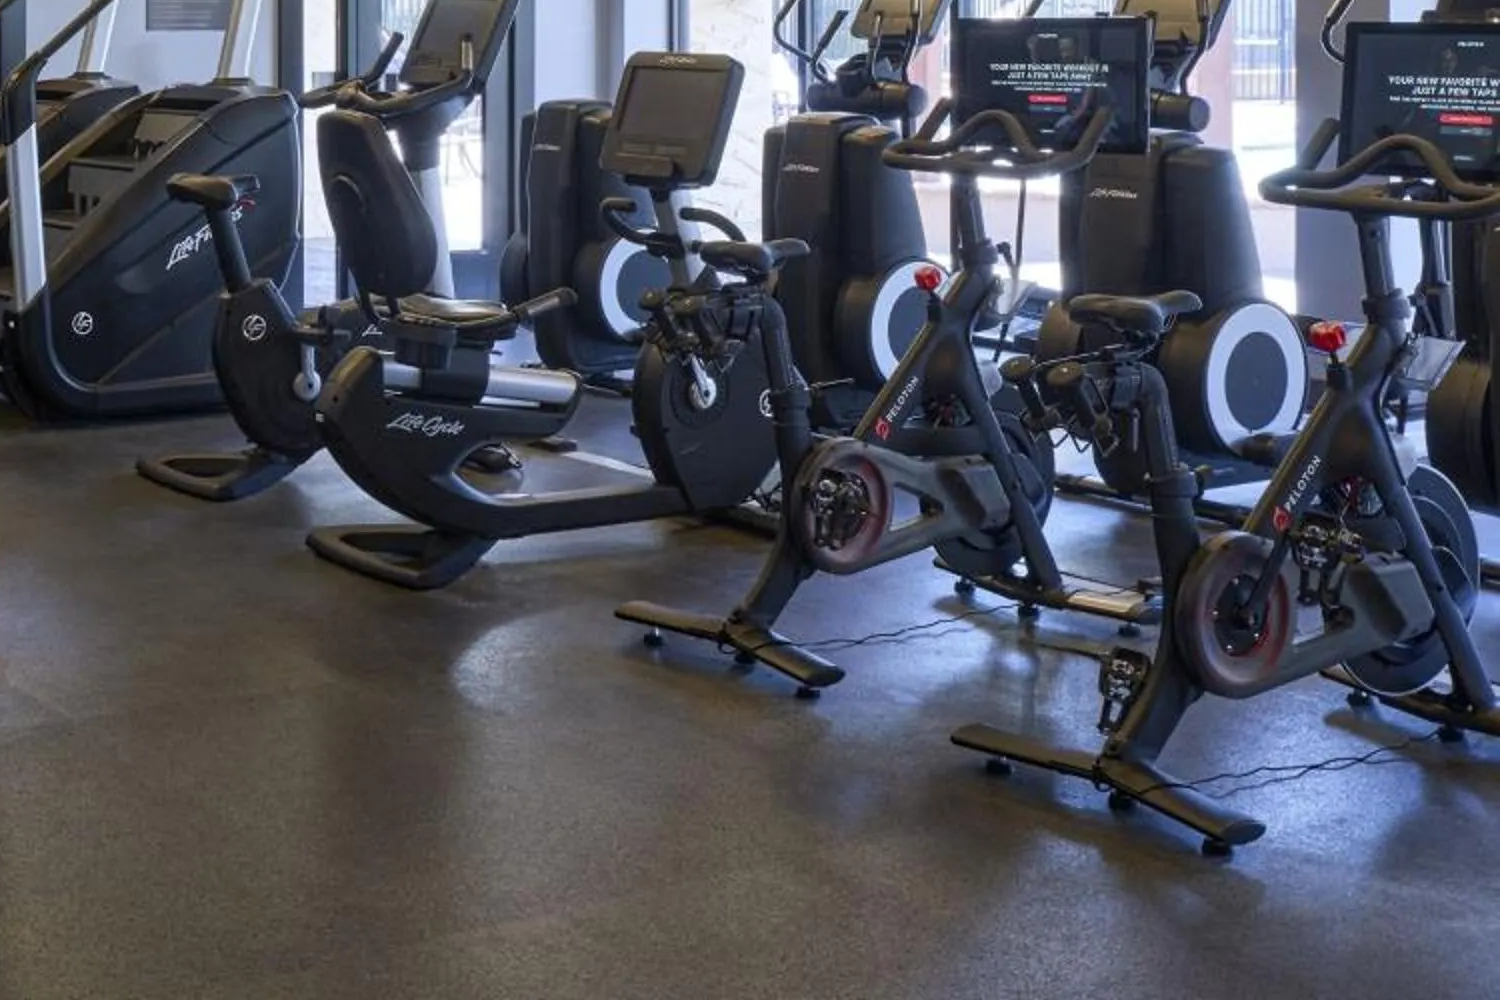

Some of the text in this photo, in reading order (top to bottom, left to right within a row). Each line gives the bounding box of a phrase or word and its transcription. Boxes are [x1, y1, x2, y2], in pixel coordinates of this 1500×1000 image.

[1388, 76, 1415, 85] YOUR
[1416, 76, 1438, 86] NEW
[1441, 77, 1488, 87] FAVORITE
[1412, 86, 1436, 96] JUST
[1448, 87, 1470, 96] FEW
[1472, 88, 1498, 97] TAPS
[885, 375, 919, 423] PELOTON
[1283, 454, 1322, 513] PELOTON
